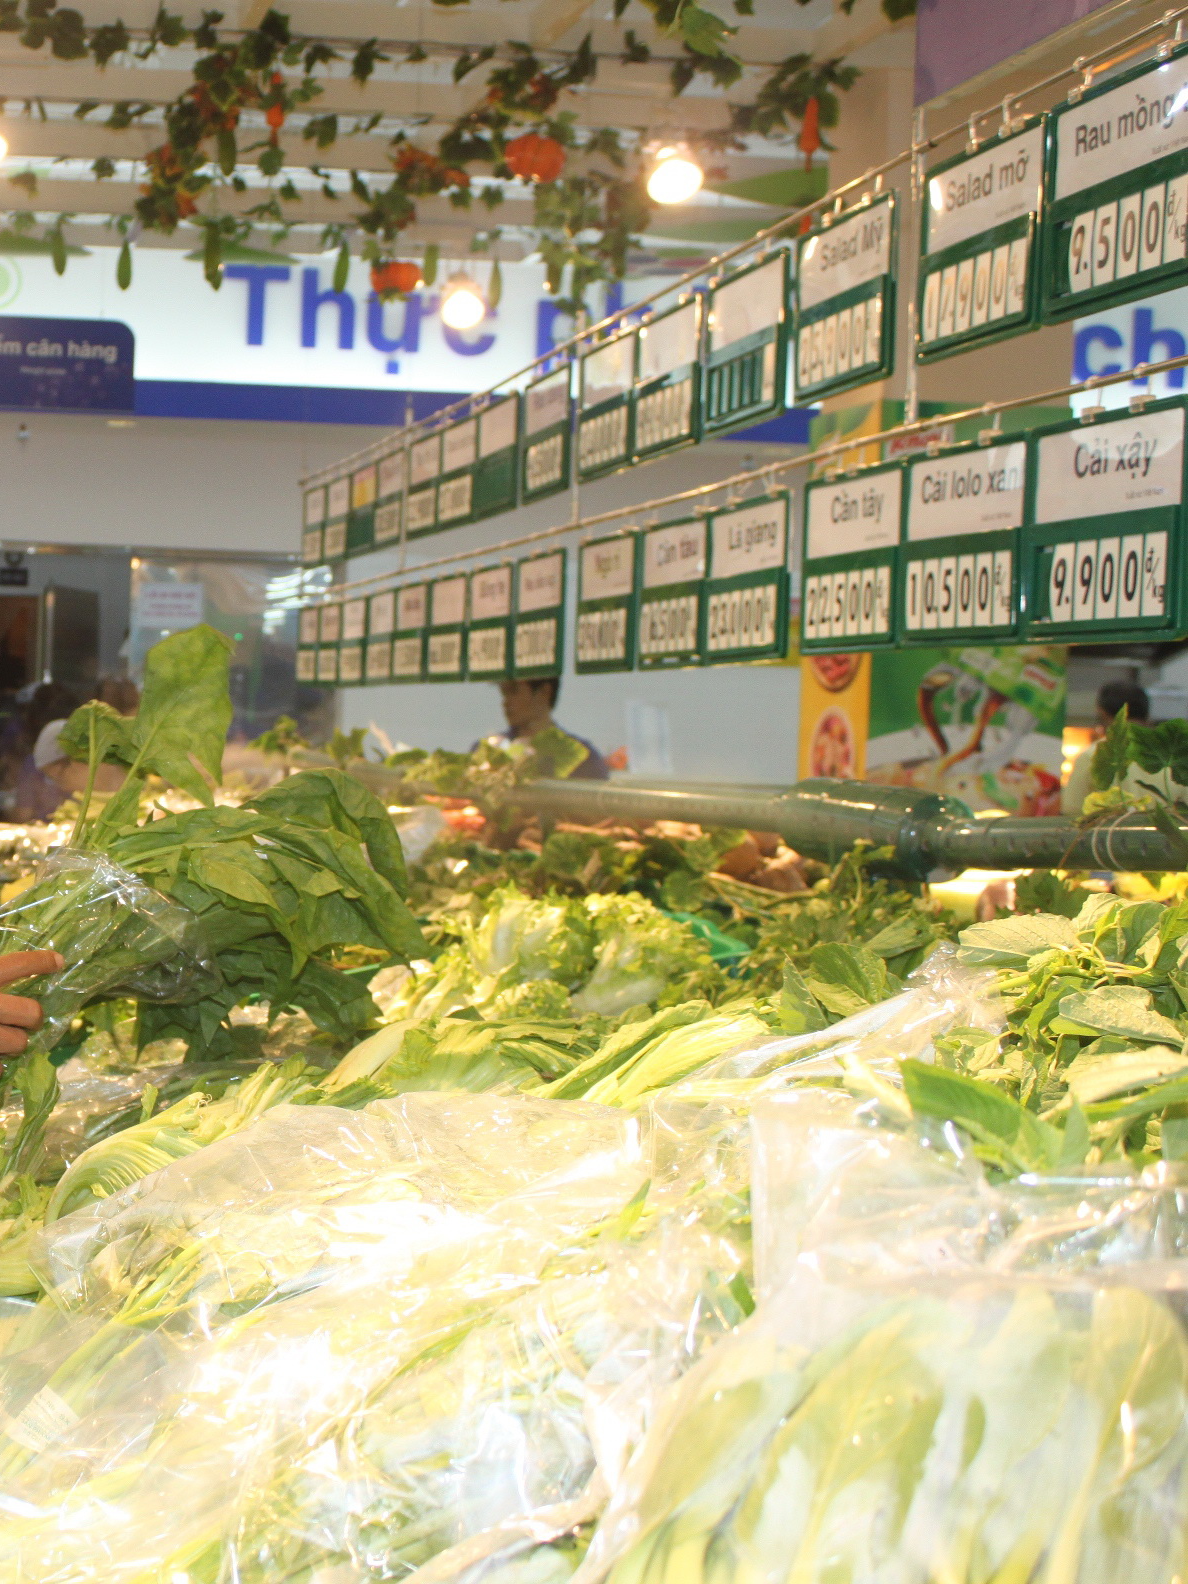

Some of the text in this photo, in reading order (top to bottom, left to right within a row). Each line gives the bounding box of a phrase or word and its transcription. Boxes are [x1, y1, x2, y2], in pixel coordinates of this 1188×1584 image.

[1075, 121, 1111, 156] Rau
[945, 149, 1030, 212] Salad mỡ
[820, 230, 858, 272] Salad
[1071, 201, 1160, 276] 9.500
[25, 338, 64, 358] cân
[67, 339, 119, 365] hàng
[1075, 431, 1158, 480] Cải xậy
[831, 487, 884, 524] Cần tây
[921, 469, 948, 505] Cải
[951, 467, 982, 500] lolo
[911, 566, 989, 616] 10.500
[1053, 550, 1138, 607] 9.900
